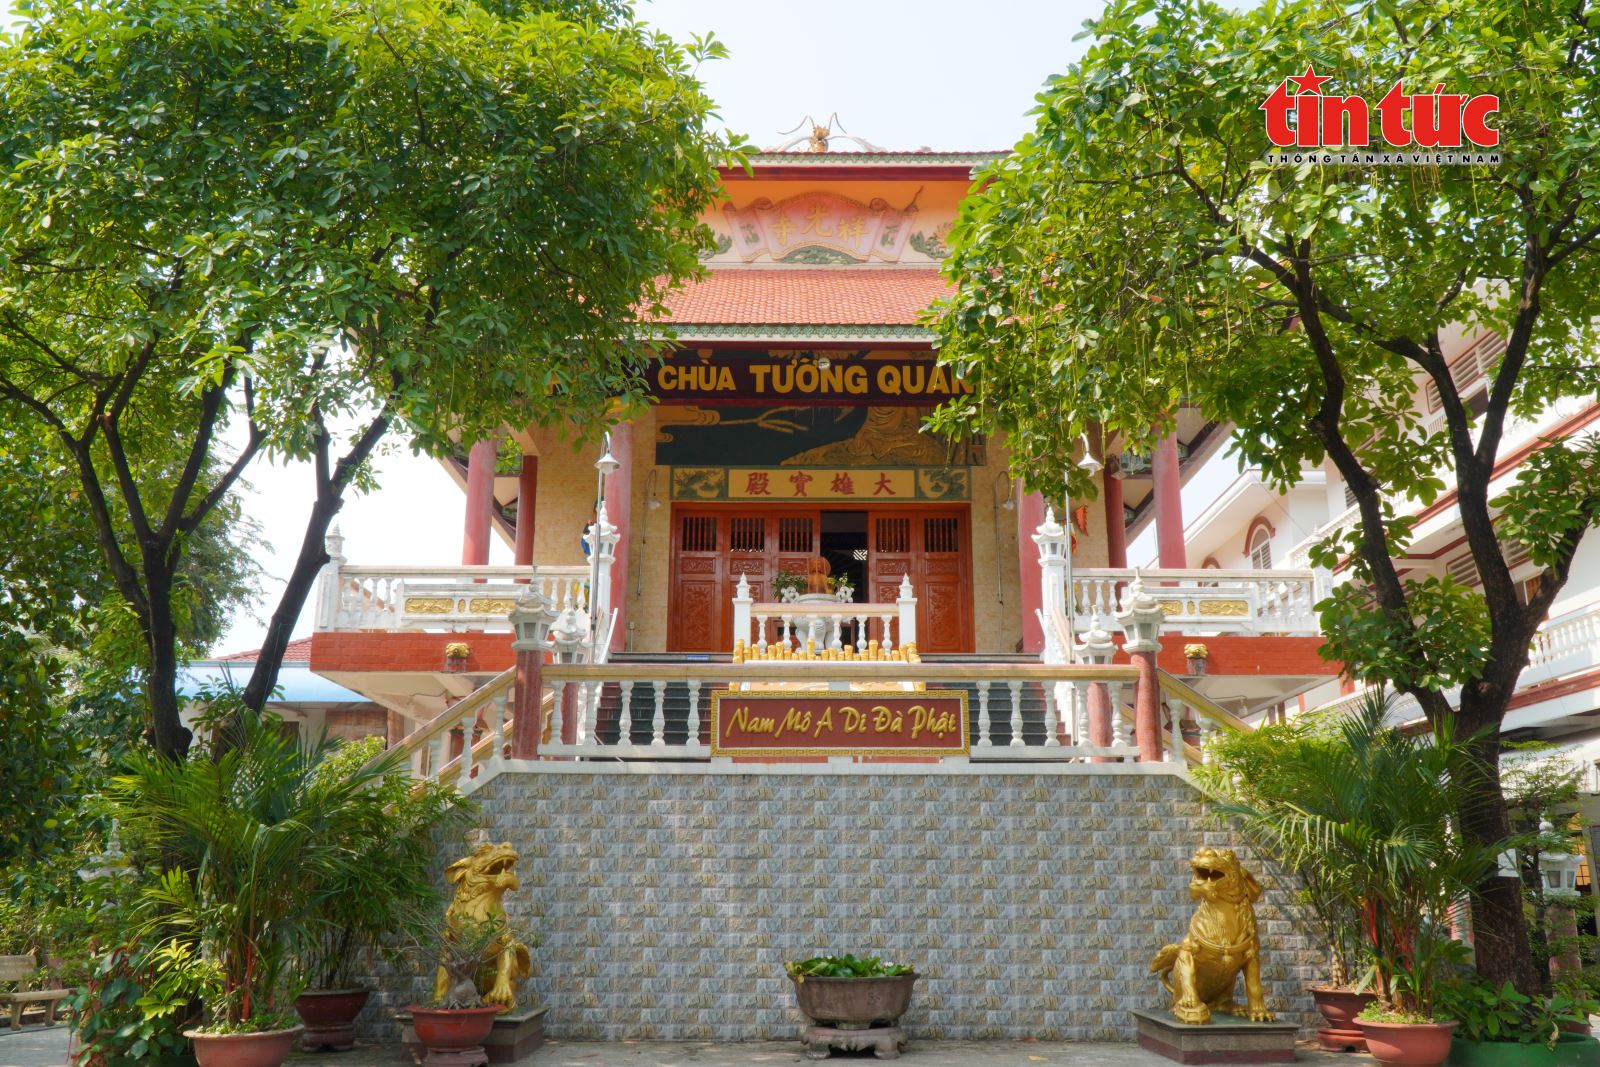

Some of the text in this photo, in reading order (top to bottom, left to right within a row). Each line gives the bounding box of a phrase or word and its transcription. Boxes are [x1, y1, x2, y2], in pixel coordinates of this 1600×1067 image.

[657, 357, 977, 396] CHÙA TƯỜNG QUAN
[725, 705, 957, 740] Nam Mô A Di Đà Phật
